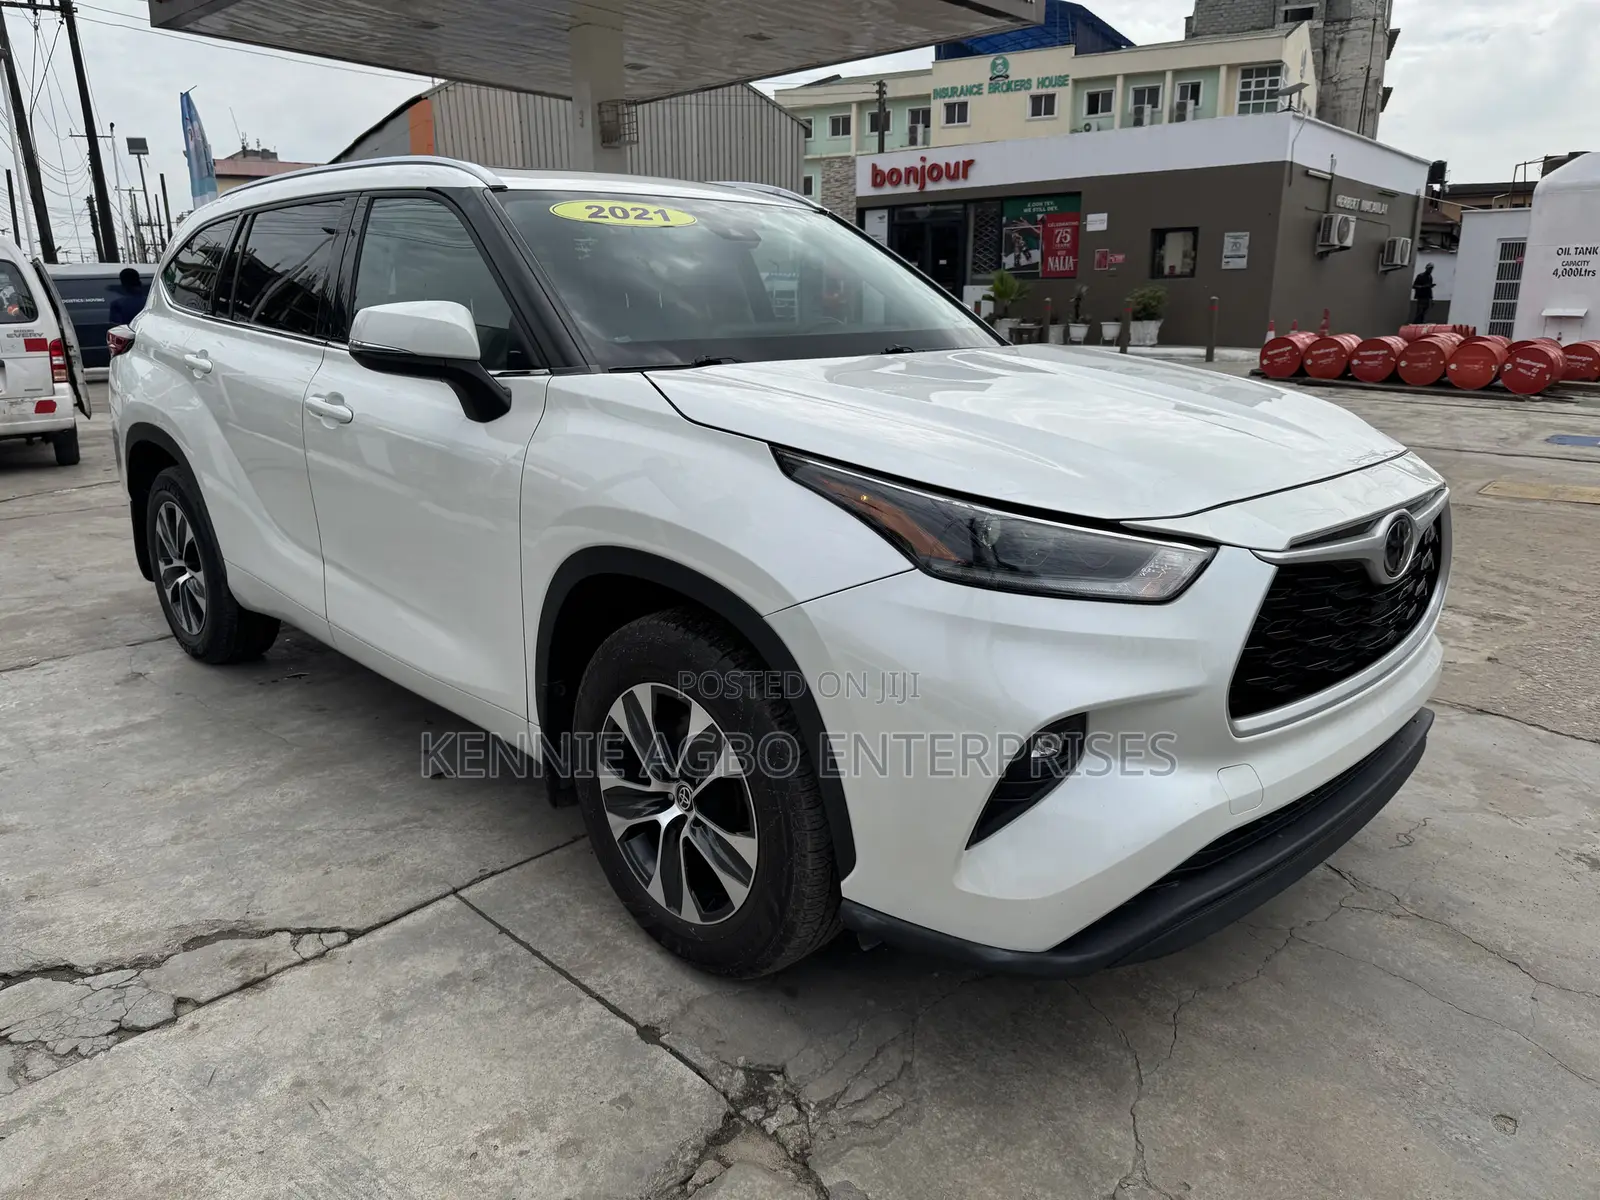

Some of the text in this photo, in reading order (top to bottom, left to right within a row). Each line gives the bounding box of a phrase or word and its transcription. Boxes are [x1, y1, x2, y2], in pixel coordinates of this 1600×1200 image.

[933, 74, 1070, 100] INSURANCE BROKERS HOUSE
[871, 156, 975, 190] bonjour
[584, 204, 671, 222] 2021
[1055, 229, 1072, 244] 75
[1556, 246, 1599, 256] OIL TANK
[1047, 256, 1074, 272] NAIJA
[1552, 268, 1596, 279] 4,000Ltrs
